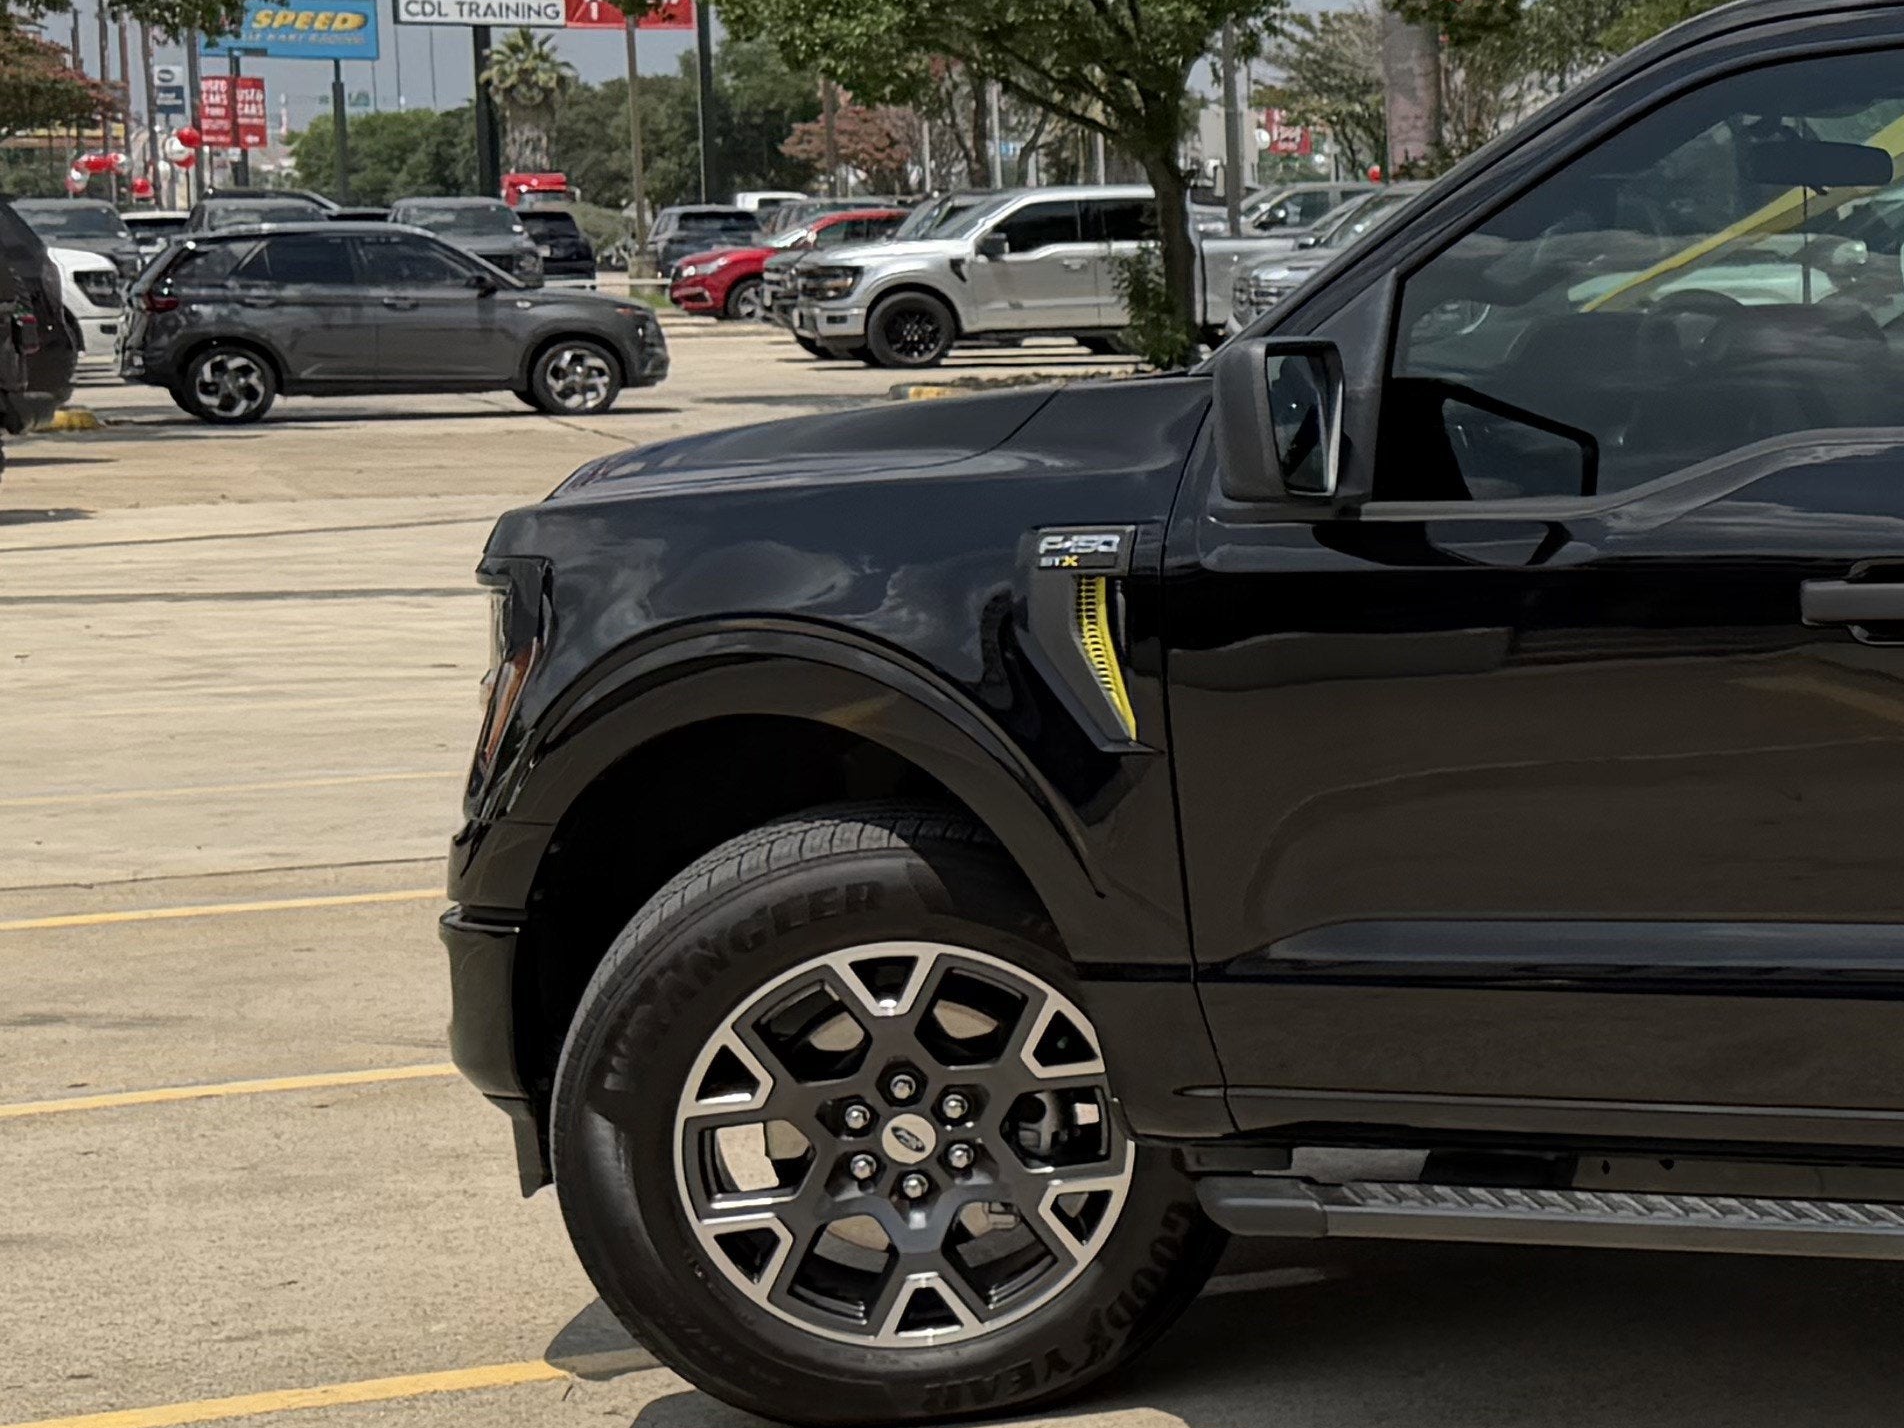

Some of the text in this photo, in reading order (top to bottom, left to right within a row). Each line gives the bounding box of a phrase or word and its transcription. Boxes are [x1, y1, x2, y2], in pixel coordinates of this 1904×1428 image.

[404, 0, 561, 20] CDL TRAINING
[252, 9, 369, 32] SPEED
[1040, 555, 1080, 567] STX
